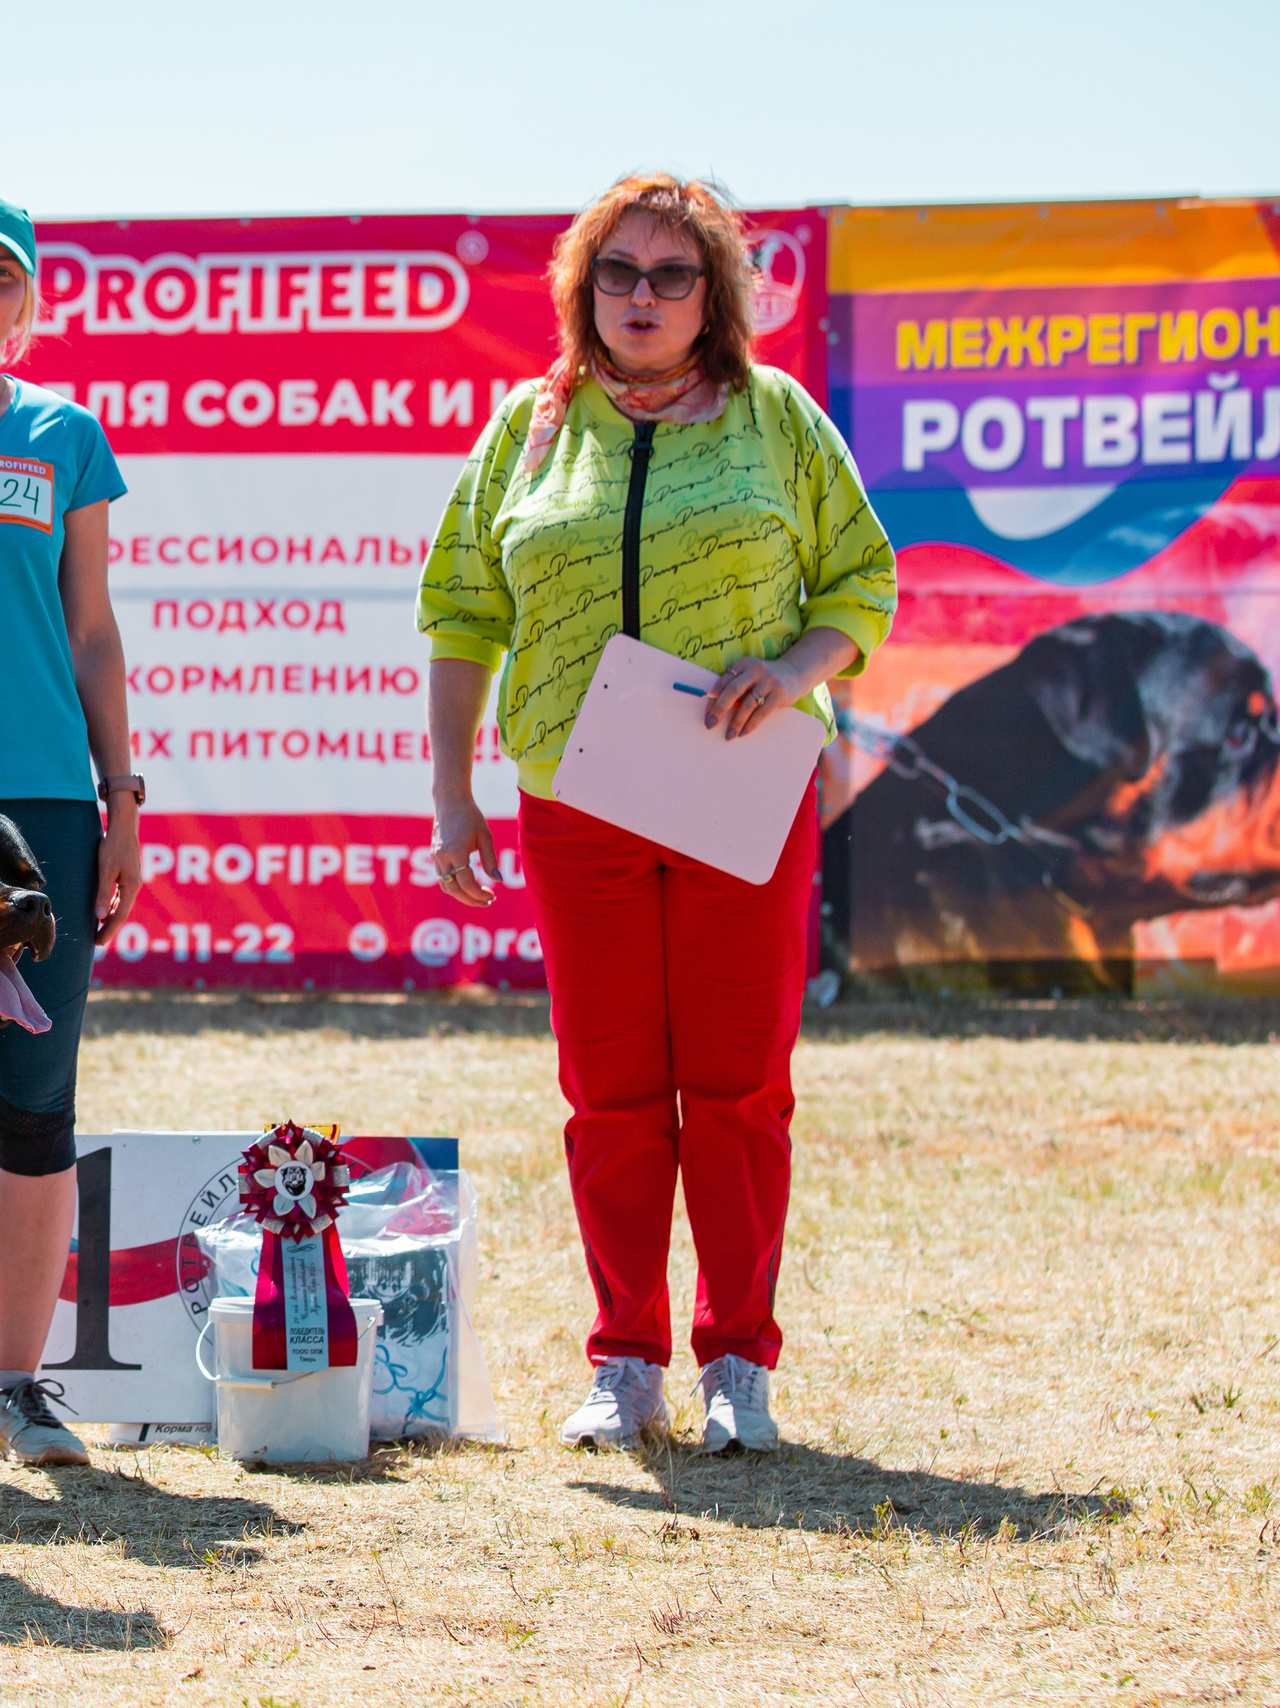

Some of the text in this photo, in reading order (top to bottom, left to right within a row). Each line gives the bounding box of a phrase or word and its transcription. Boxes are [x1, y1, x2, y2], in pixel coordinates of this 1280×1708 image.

[37, 247, 463, 329] PROFIFEED
[895, 306, 1280, 370] МЕЖРЕГИОН
[183, 378, 414, 427] СОБАК
[428, 379, 474, 427] И
[152, 598, 347, 635] ПОДХОД
[126, 664, 420, 695] КОРМЛЕНИЮ
[141, 843, 526, 889] PROFIPETSU
[94, 921, 296, 963] 0-11-22
[41, 1147, 142, 1370] 1
[289, 1327, 326, 1336] ПОБЕДИТЕЛЬ
[289, 1335, 325, 1344] КЛАССА
[155, 1424, 192, 1435] Корма
